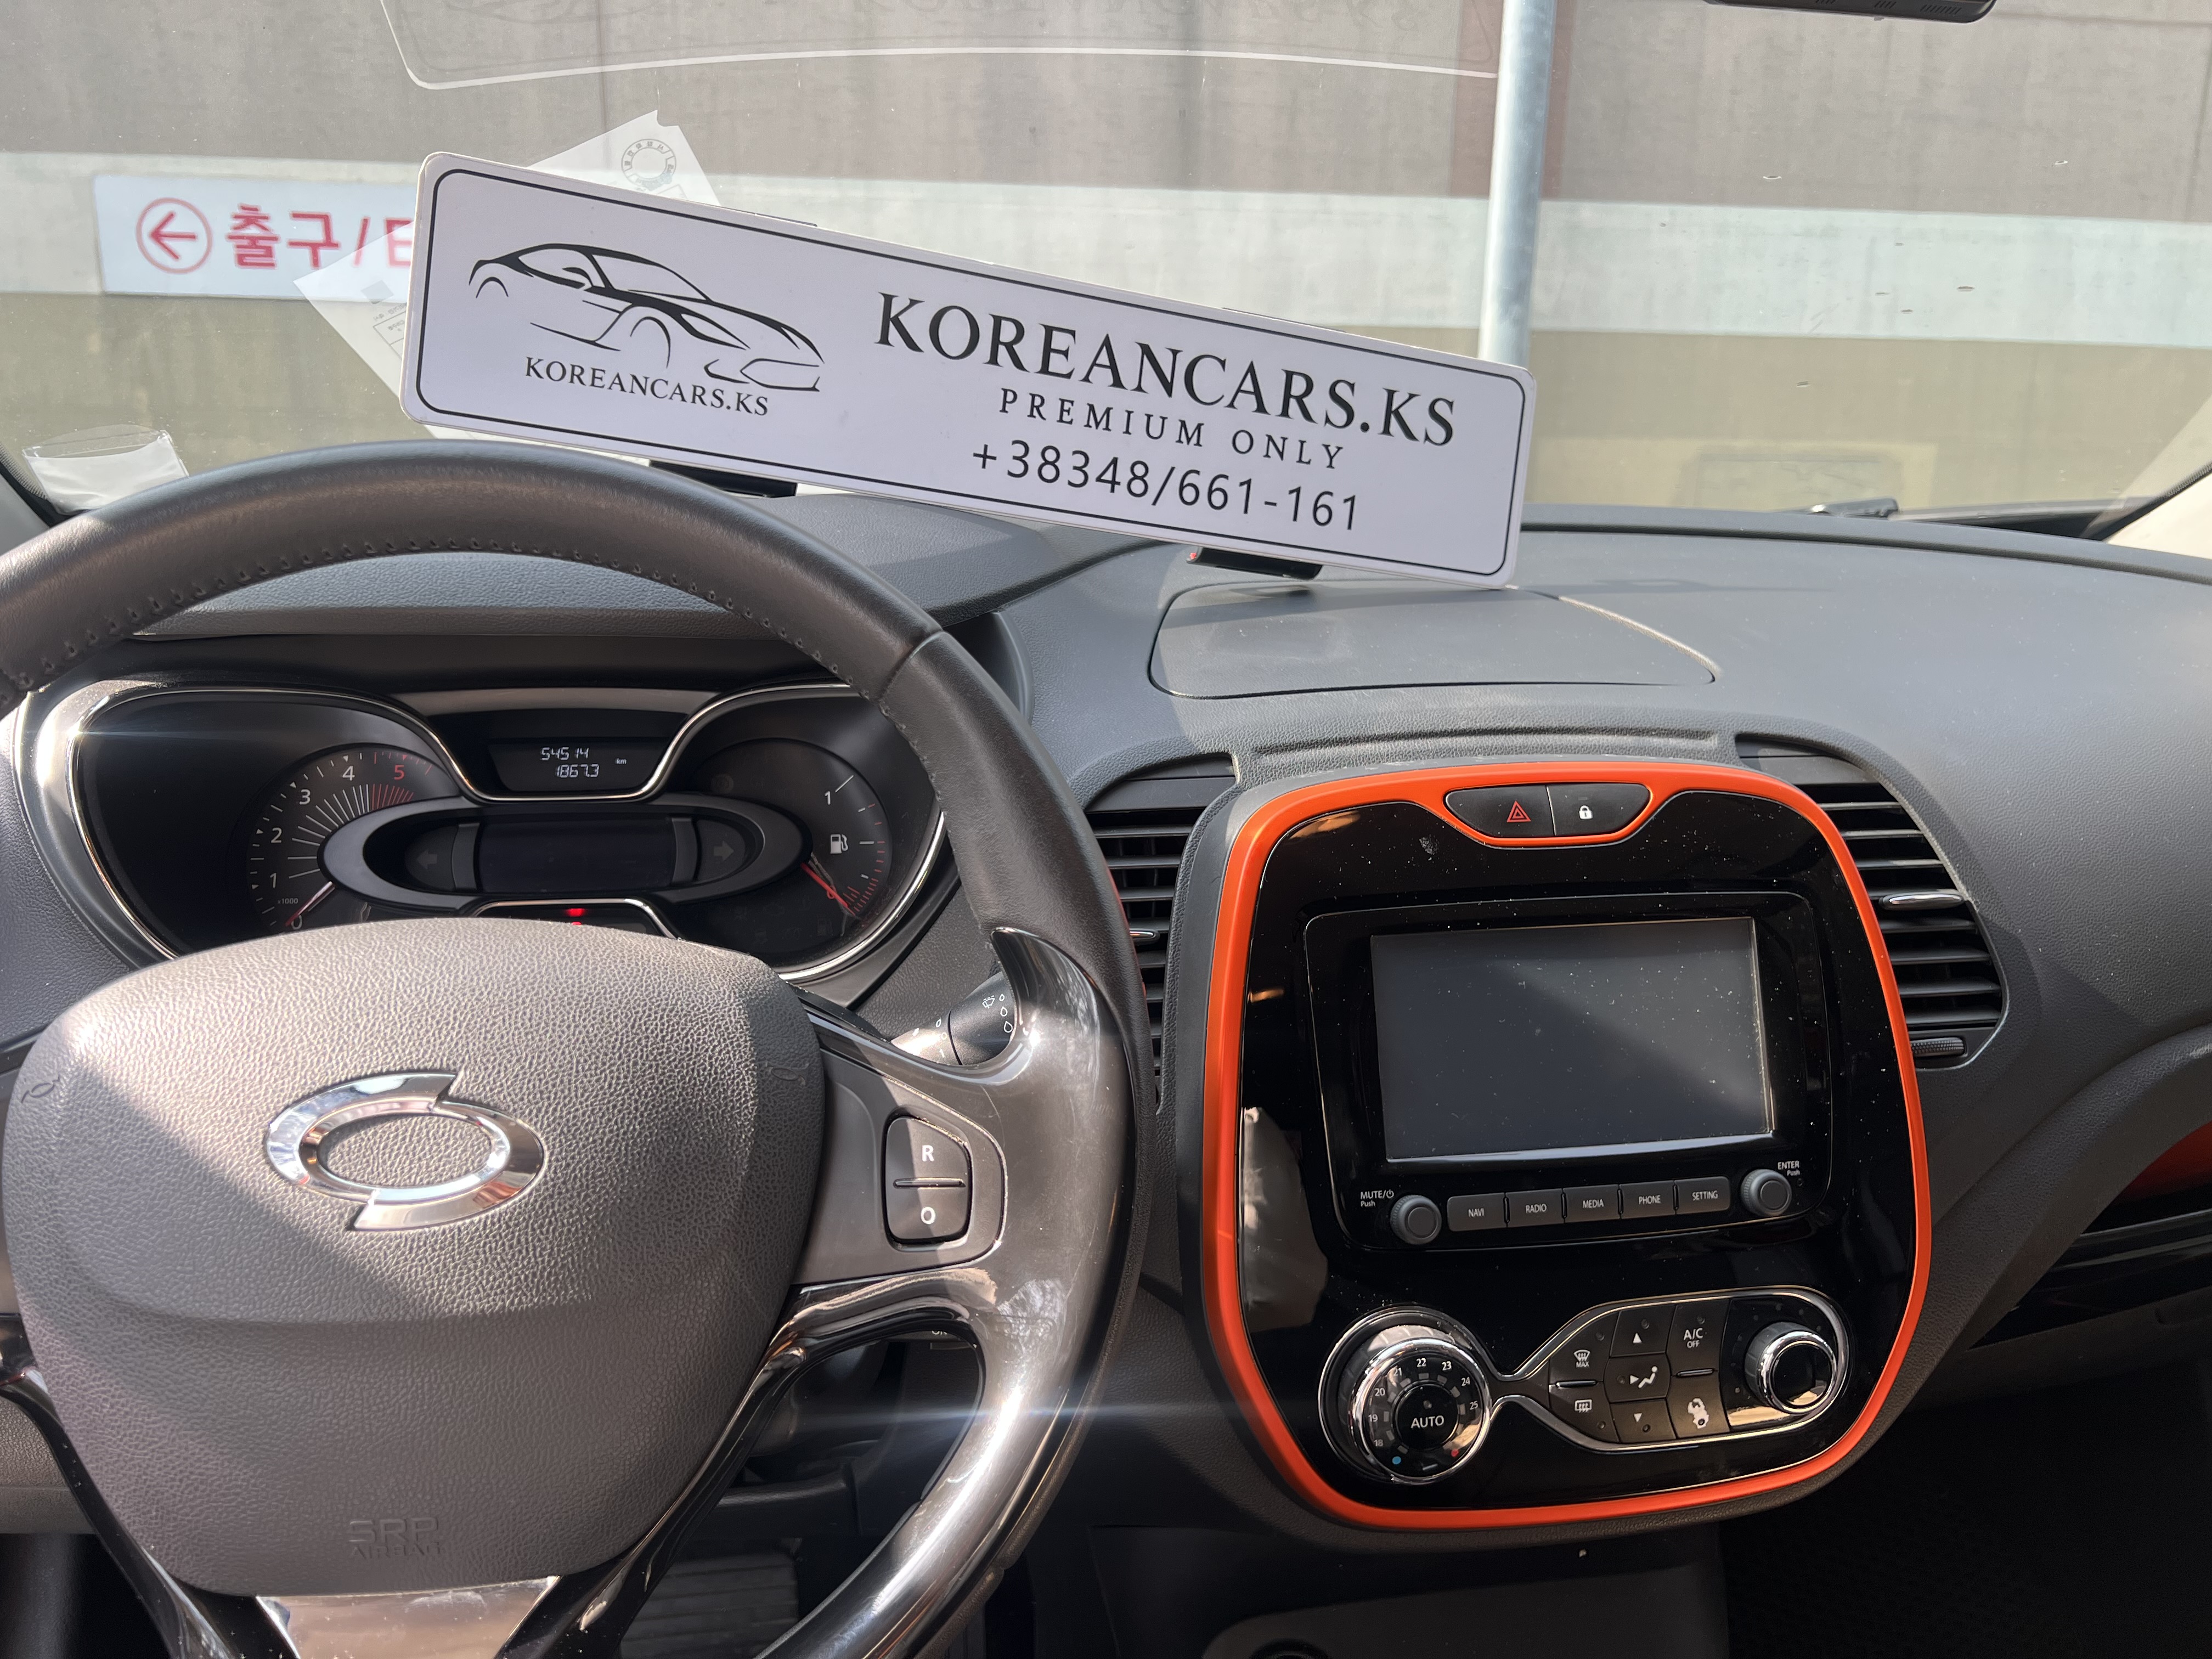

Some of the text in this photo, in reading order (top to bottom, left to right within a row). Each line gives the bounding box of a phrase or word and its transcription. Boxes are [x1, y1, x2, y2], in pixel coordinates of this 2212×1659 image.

[873, 291, 1457, 448] KOREANCARS.KS
[525, 356, 769, 416] KOREANCARS.KS
[998, 387, 1345, 471] PREMIUM ONLY
[972, 438, 1359, 532] +38348/661-161
[540, 747, 589, 761] 54514
[342, 765, 355, 781] 4
[393, 765, 405, 780] 5
[299, 789, 311, 805] 3
[825, 791, 831, 805] 1
[270, 828, 283, 843] 2
[269, 872, 277, 888] 1
[922, 1145, 934, 1162] R
[1778, 1160, 1799, 1170] ENTER
[1638, 1194, 1661, 1205] PHONE
[1692, 1190, 1718, 1201] SETTING
[1525, 1203, 1547, 1214] RADIO
[1582, 1199, 1604, 1209] MEDIA
[1468, 1208, 1485, 1217] NAVI
[1683, 1328, 1703, 1341] A/C
[1686, 1341, 1700, 1349] OFF
[1416, 1357, 1426, 1368] 22
[1441, 1361, 1452, 1371] 23
[1461, 1376, 1471, 1387] 24
[1374, 1388, 1386, 1397] 20
[1469, 1400, 1479, 1411] 25
[1368, 1414, 1379, 1423] 19
[1410, 1415, 1445, 1429] AUTO
[1373, 1438, 1384, 1447] 18
